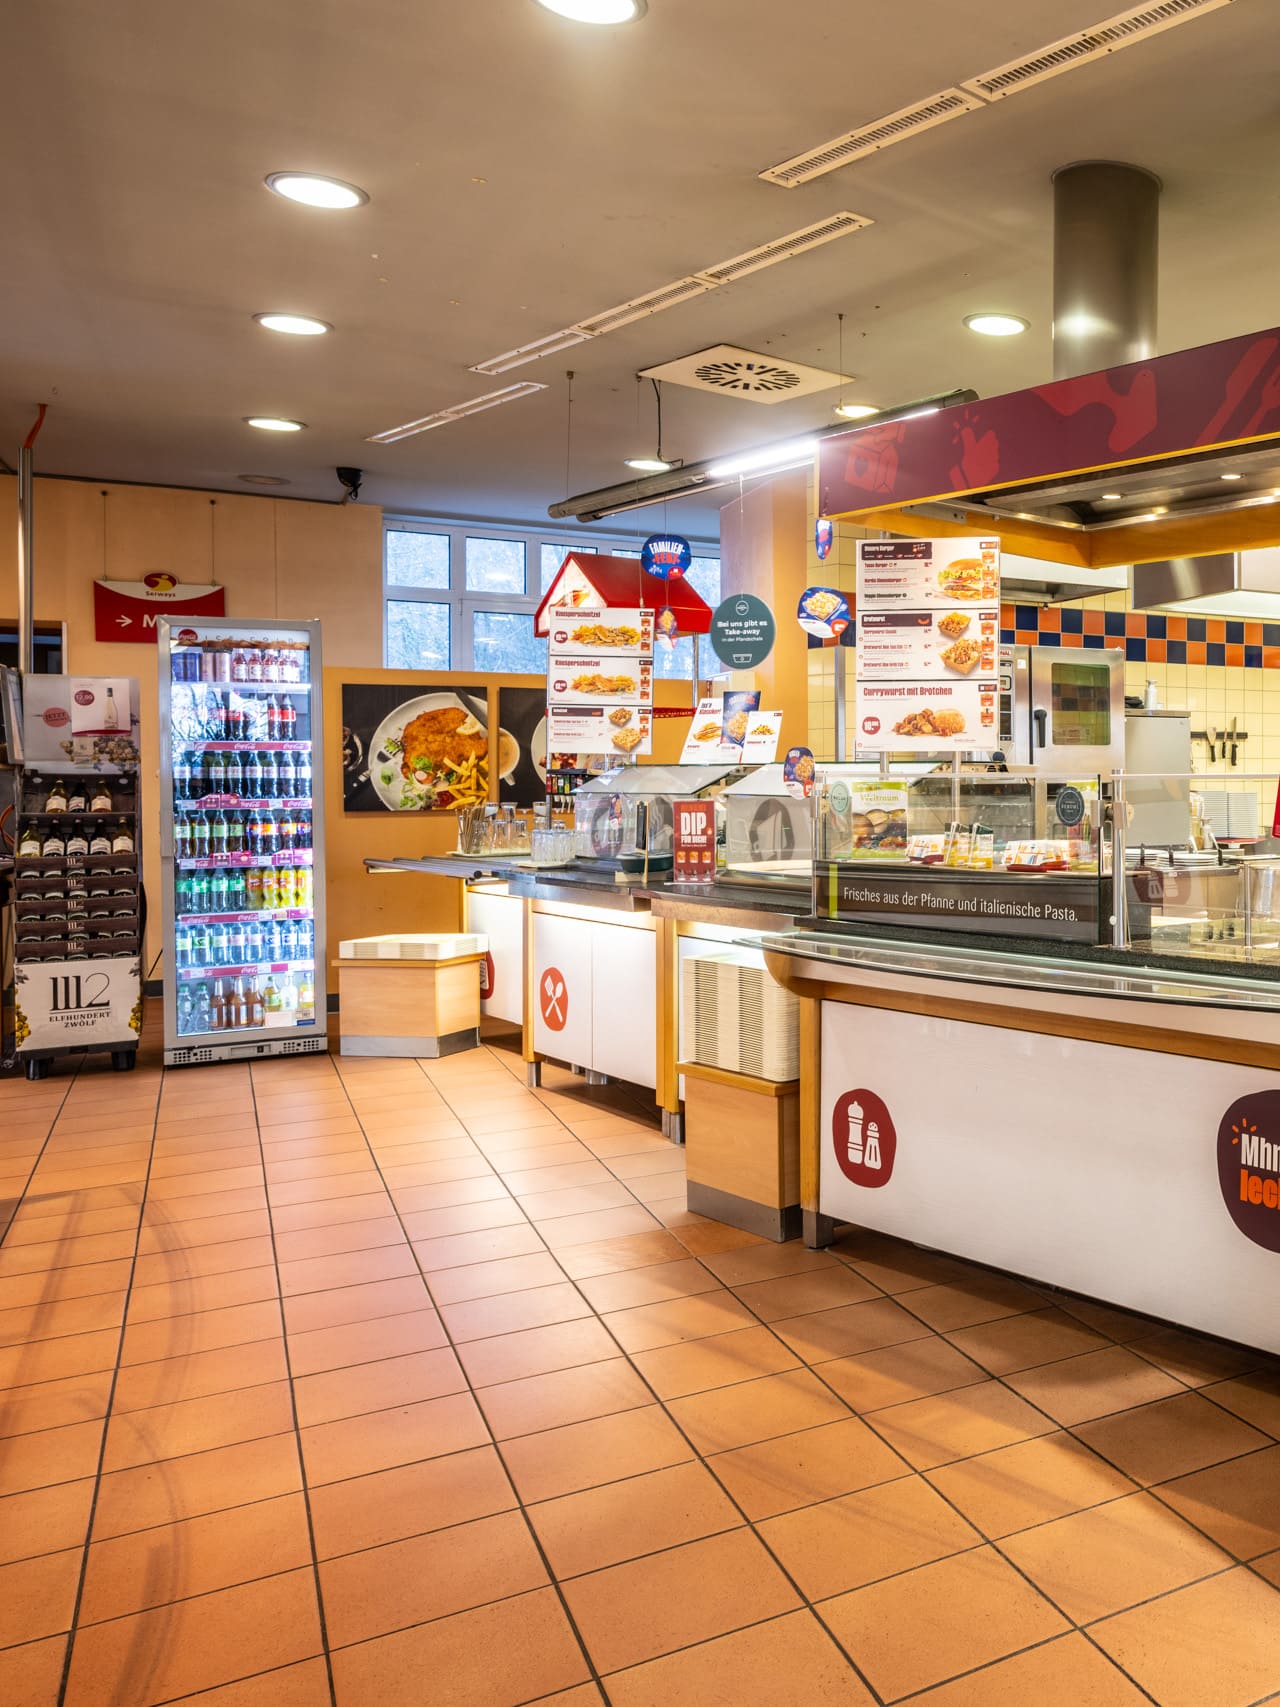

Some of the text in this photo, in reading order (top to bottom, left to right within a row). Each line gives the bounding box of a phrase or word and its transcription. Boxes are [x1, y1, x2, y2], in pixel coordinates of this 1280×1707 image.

[145, 590, 176, 598] Serways
[744, 619, 758, 629] gibt
[724, 628, 760, 637] Take-away
[863, 687, 905, 696] Currywurst
[907, 687, 918, 695] mit
[680, 812, 707, 836] DIP
[843, 886, 1079, 922] Frisches aus der Pfanne und italienische Pasta.
[49, 1011, 111, 1022] ELFHUNDERT
[64, 1019, 97, 1028] ZWÖLF
